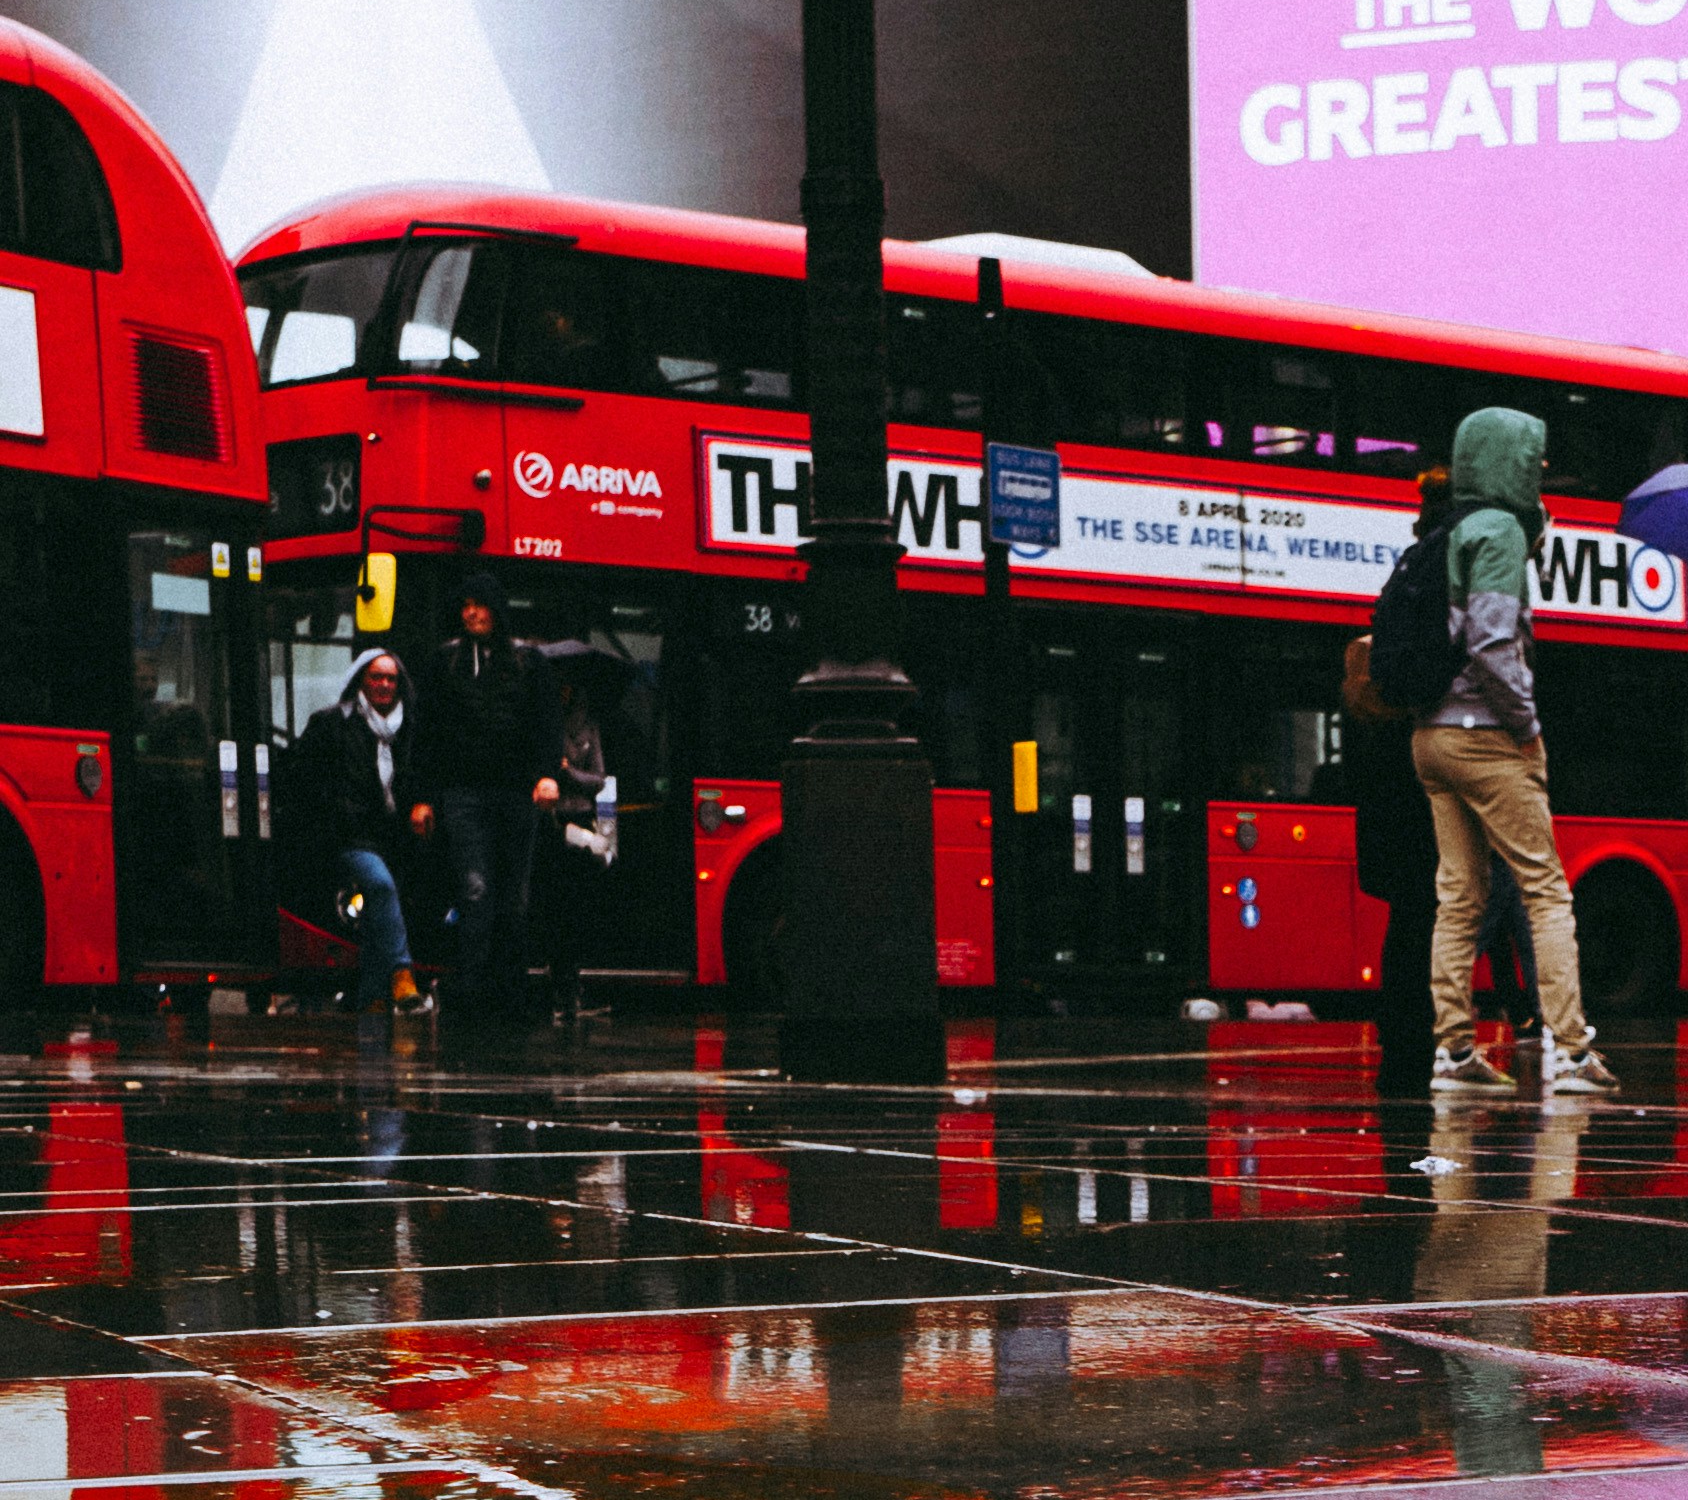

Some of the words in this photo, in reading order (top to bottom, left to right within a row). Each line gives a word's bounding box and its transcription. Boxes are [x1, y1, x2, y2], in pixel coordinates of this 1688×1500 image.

[559, 463, 663, 498] ARRIVA
[717, 454, 812, 538] TH
[1198, 501, 1250, 524] APRIL
[1260, 509, 1306, 528] 2020
[514, 537, 563, 557] LT202
[1077, 516, 1123, 541] THE
[1135, 521, 1179, 546] SSE
[1190, 527, 1278, 558] ARENA,
[1286, 536, 1402, 565] WEMBLEY
[744, 603, 773, 633] 38
